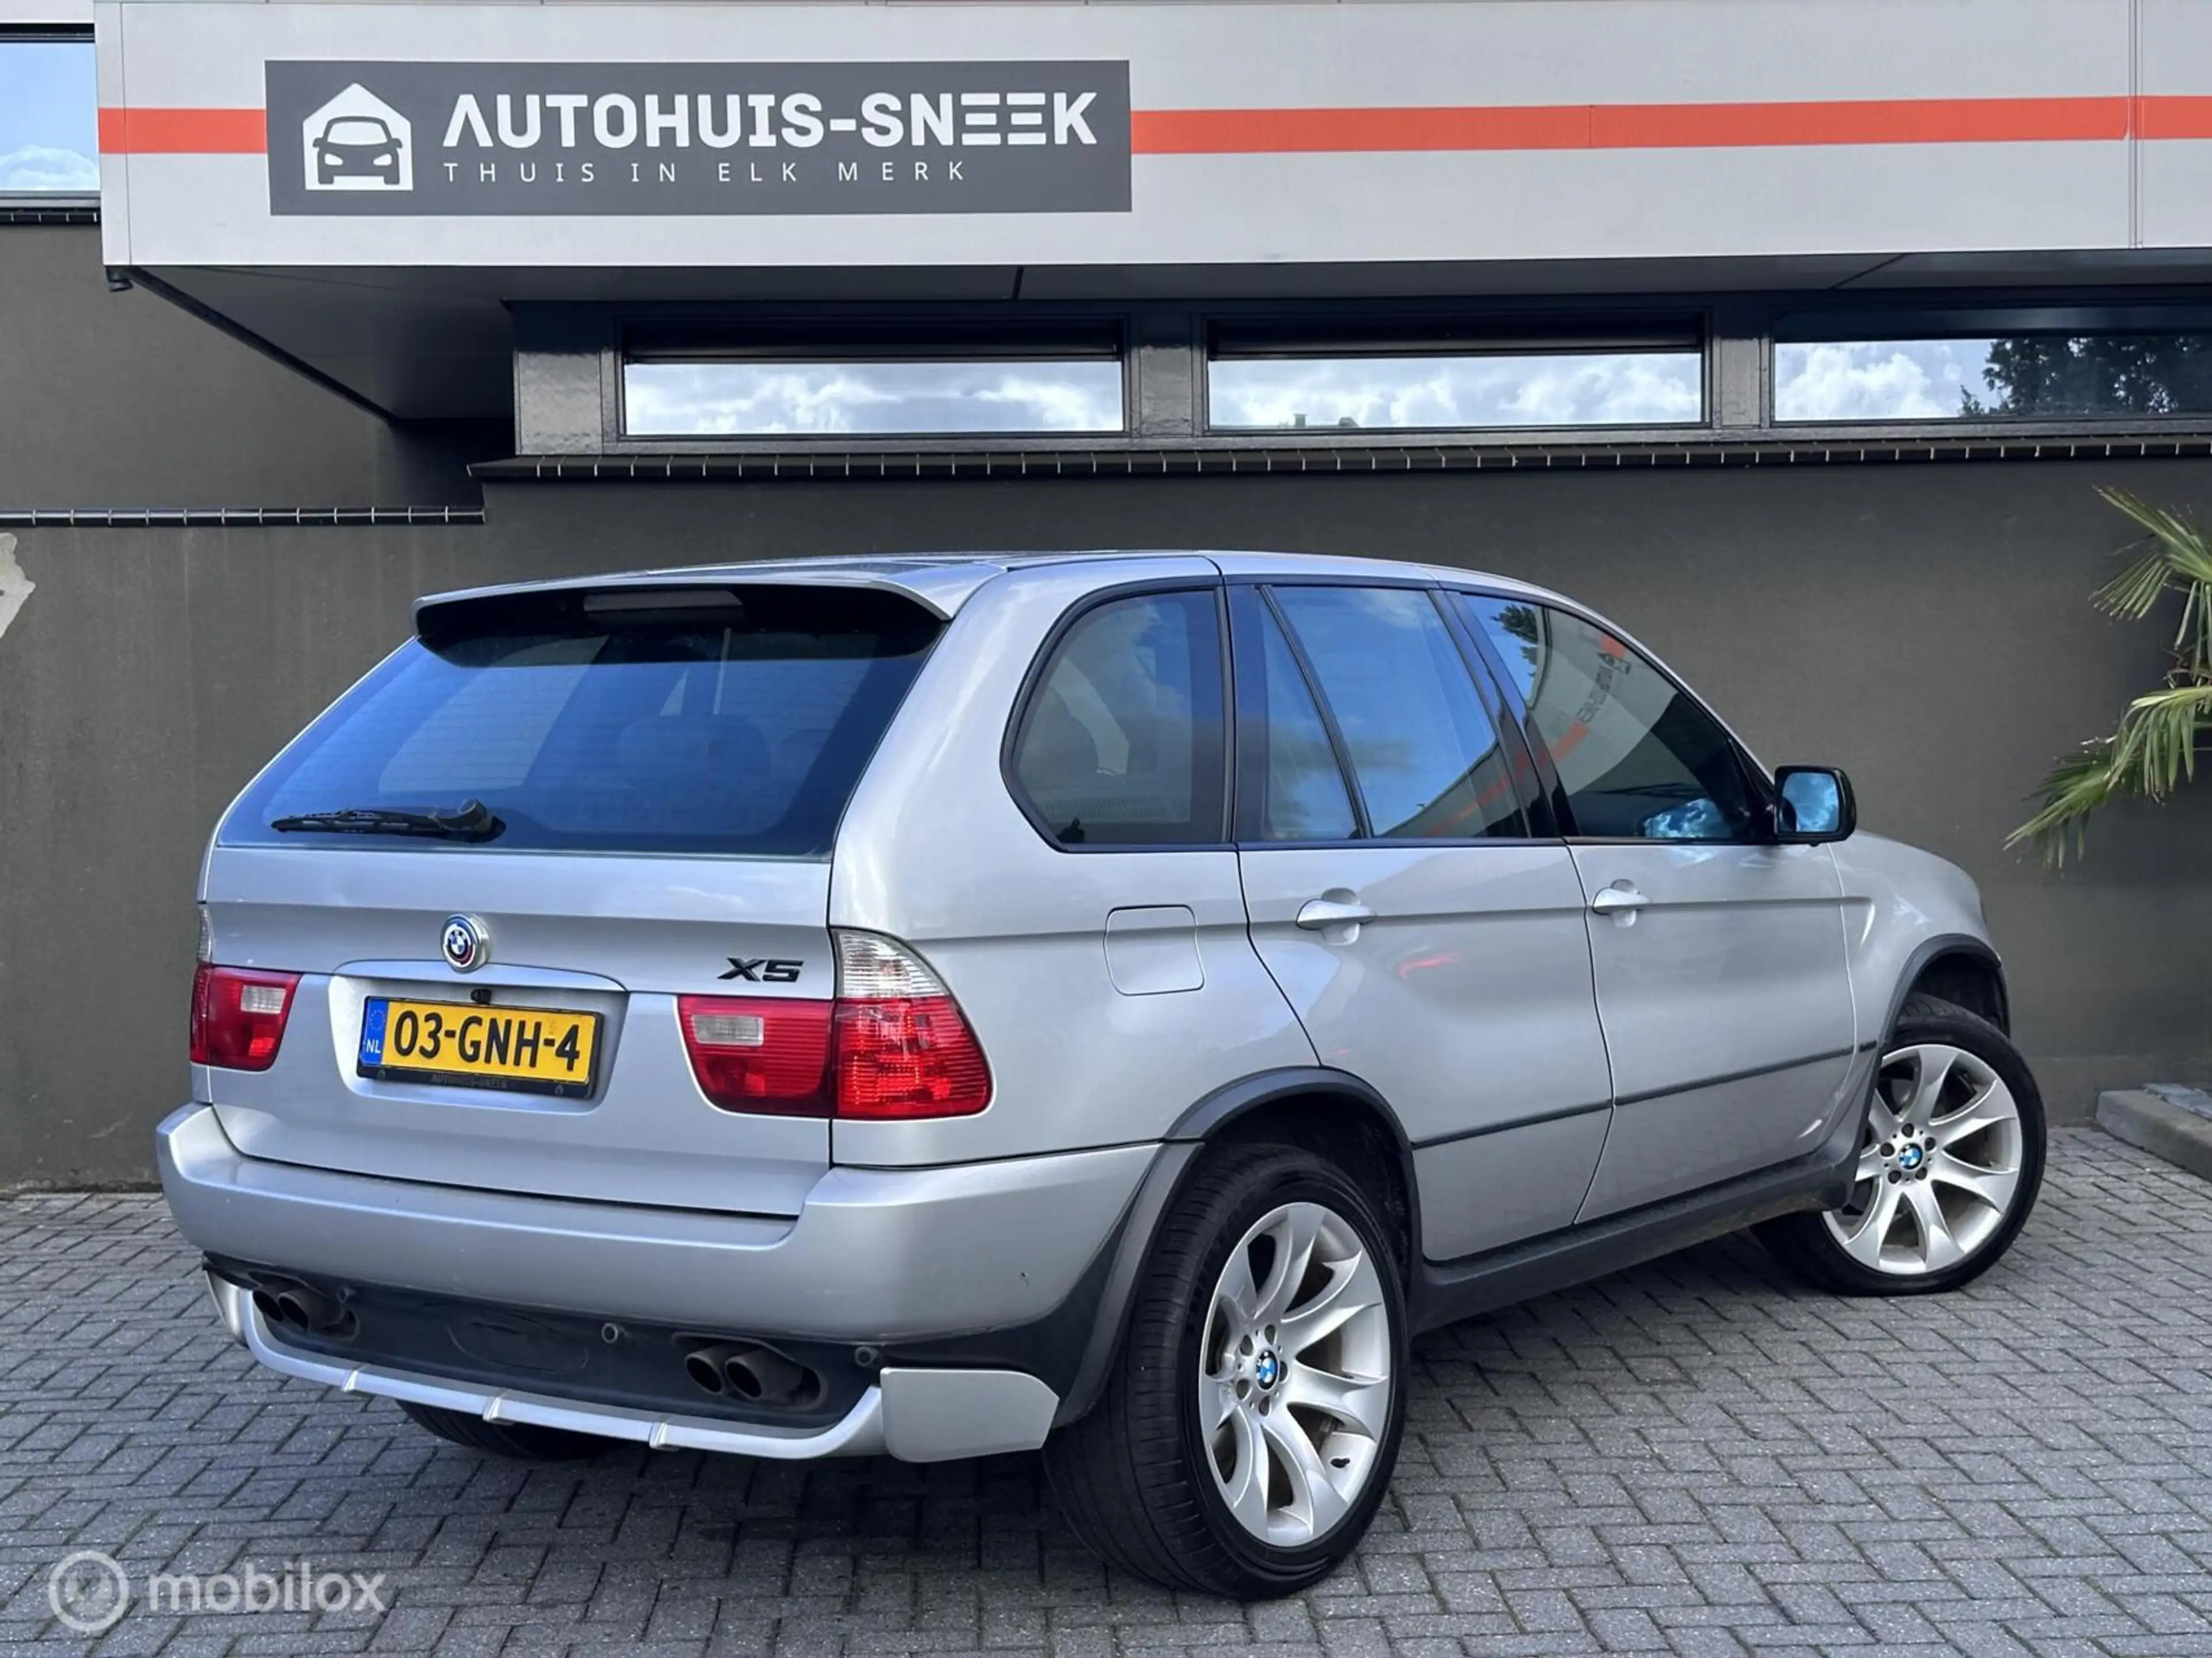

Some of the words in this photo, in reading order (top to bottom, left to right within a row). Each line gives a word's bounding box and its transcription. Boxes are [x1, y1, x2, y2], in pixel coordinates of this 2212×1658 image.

[442, 92, 1097, 149] AUTOHUIS-SNEEK
[443, 162, 594, 183] THUIS
[631, 162, 676, 183] IN
[718, 162, 797, 182] ELK
[838, 161, 964, 181] MERK
[717, 957, 804, 982] X5
[366, 1038, 381, 1054] NL
[393, 1010, 580, 1072] 03-GNH-4
